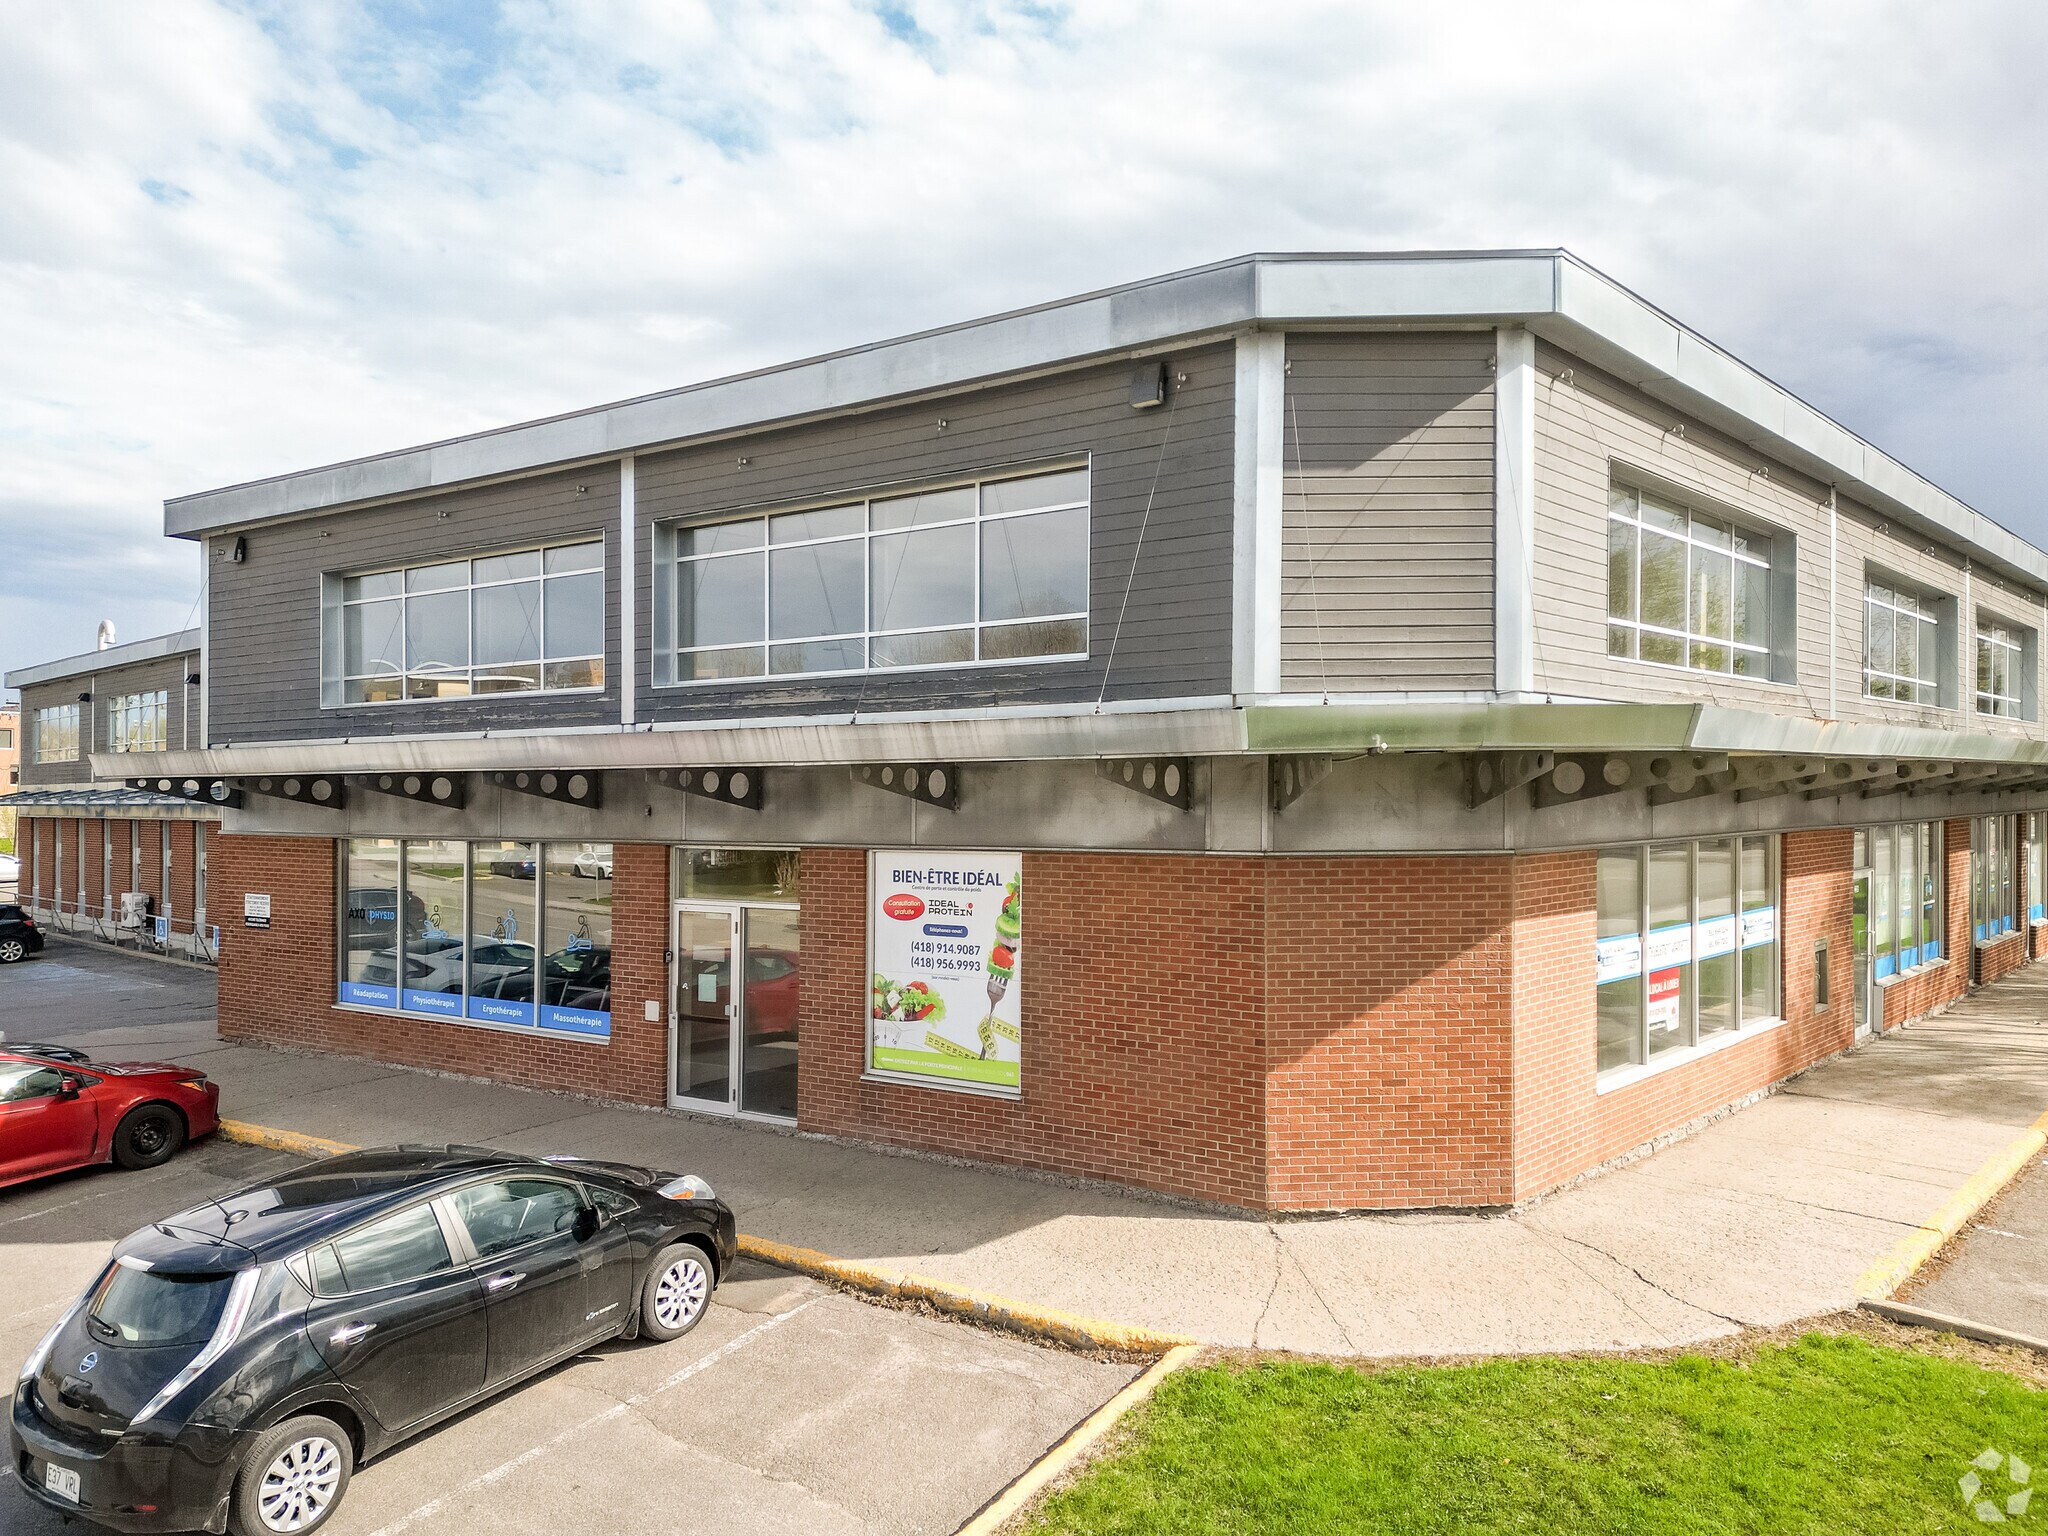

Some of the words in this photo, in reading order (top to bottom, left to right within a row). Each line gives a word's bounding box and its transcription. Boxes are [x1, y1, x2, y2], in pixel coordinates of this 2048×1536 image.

[892, 868, 960, 885] BIEN-ÊTRE
[963, 869, 1003, 887] IDÉAL
[928, 899, 959, 908] IDEAL
[348, 908, 365, 919] AXO
[894, 908, 915, 916] gratuite
[928, 907, 973, 917] PROTEIN
[911, 941, 935, 953] (418)
[936, 943, 981, 956] 914.9087
[911, 956, 935, 969] (418)
[937, 958, 981, 972] 956.9993
[353, 988, 388, 1001] Réadaptation
[1649, 982, 1663, 995] LOCAL
[412, 995, 455, 1008] Physiothérapie
[482, 1004, 523, 1018] Ergothérapie
[553, 1013, 602, 1027] Massothérapie
[48, 1467, 61, 1486] E37
[65, 1474, 77, 1495] VRL
